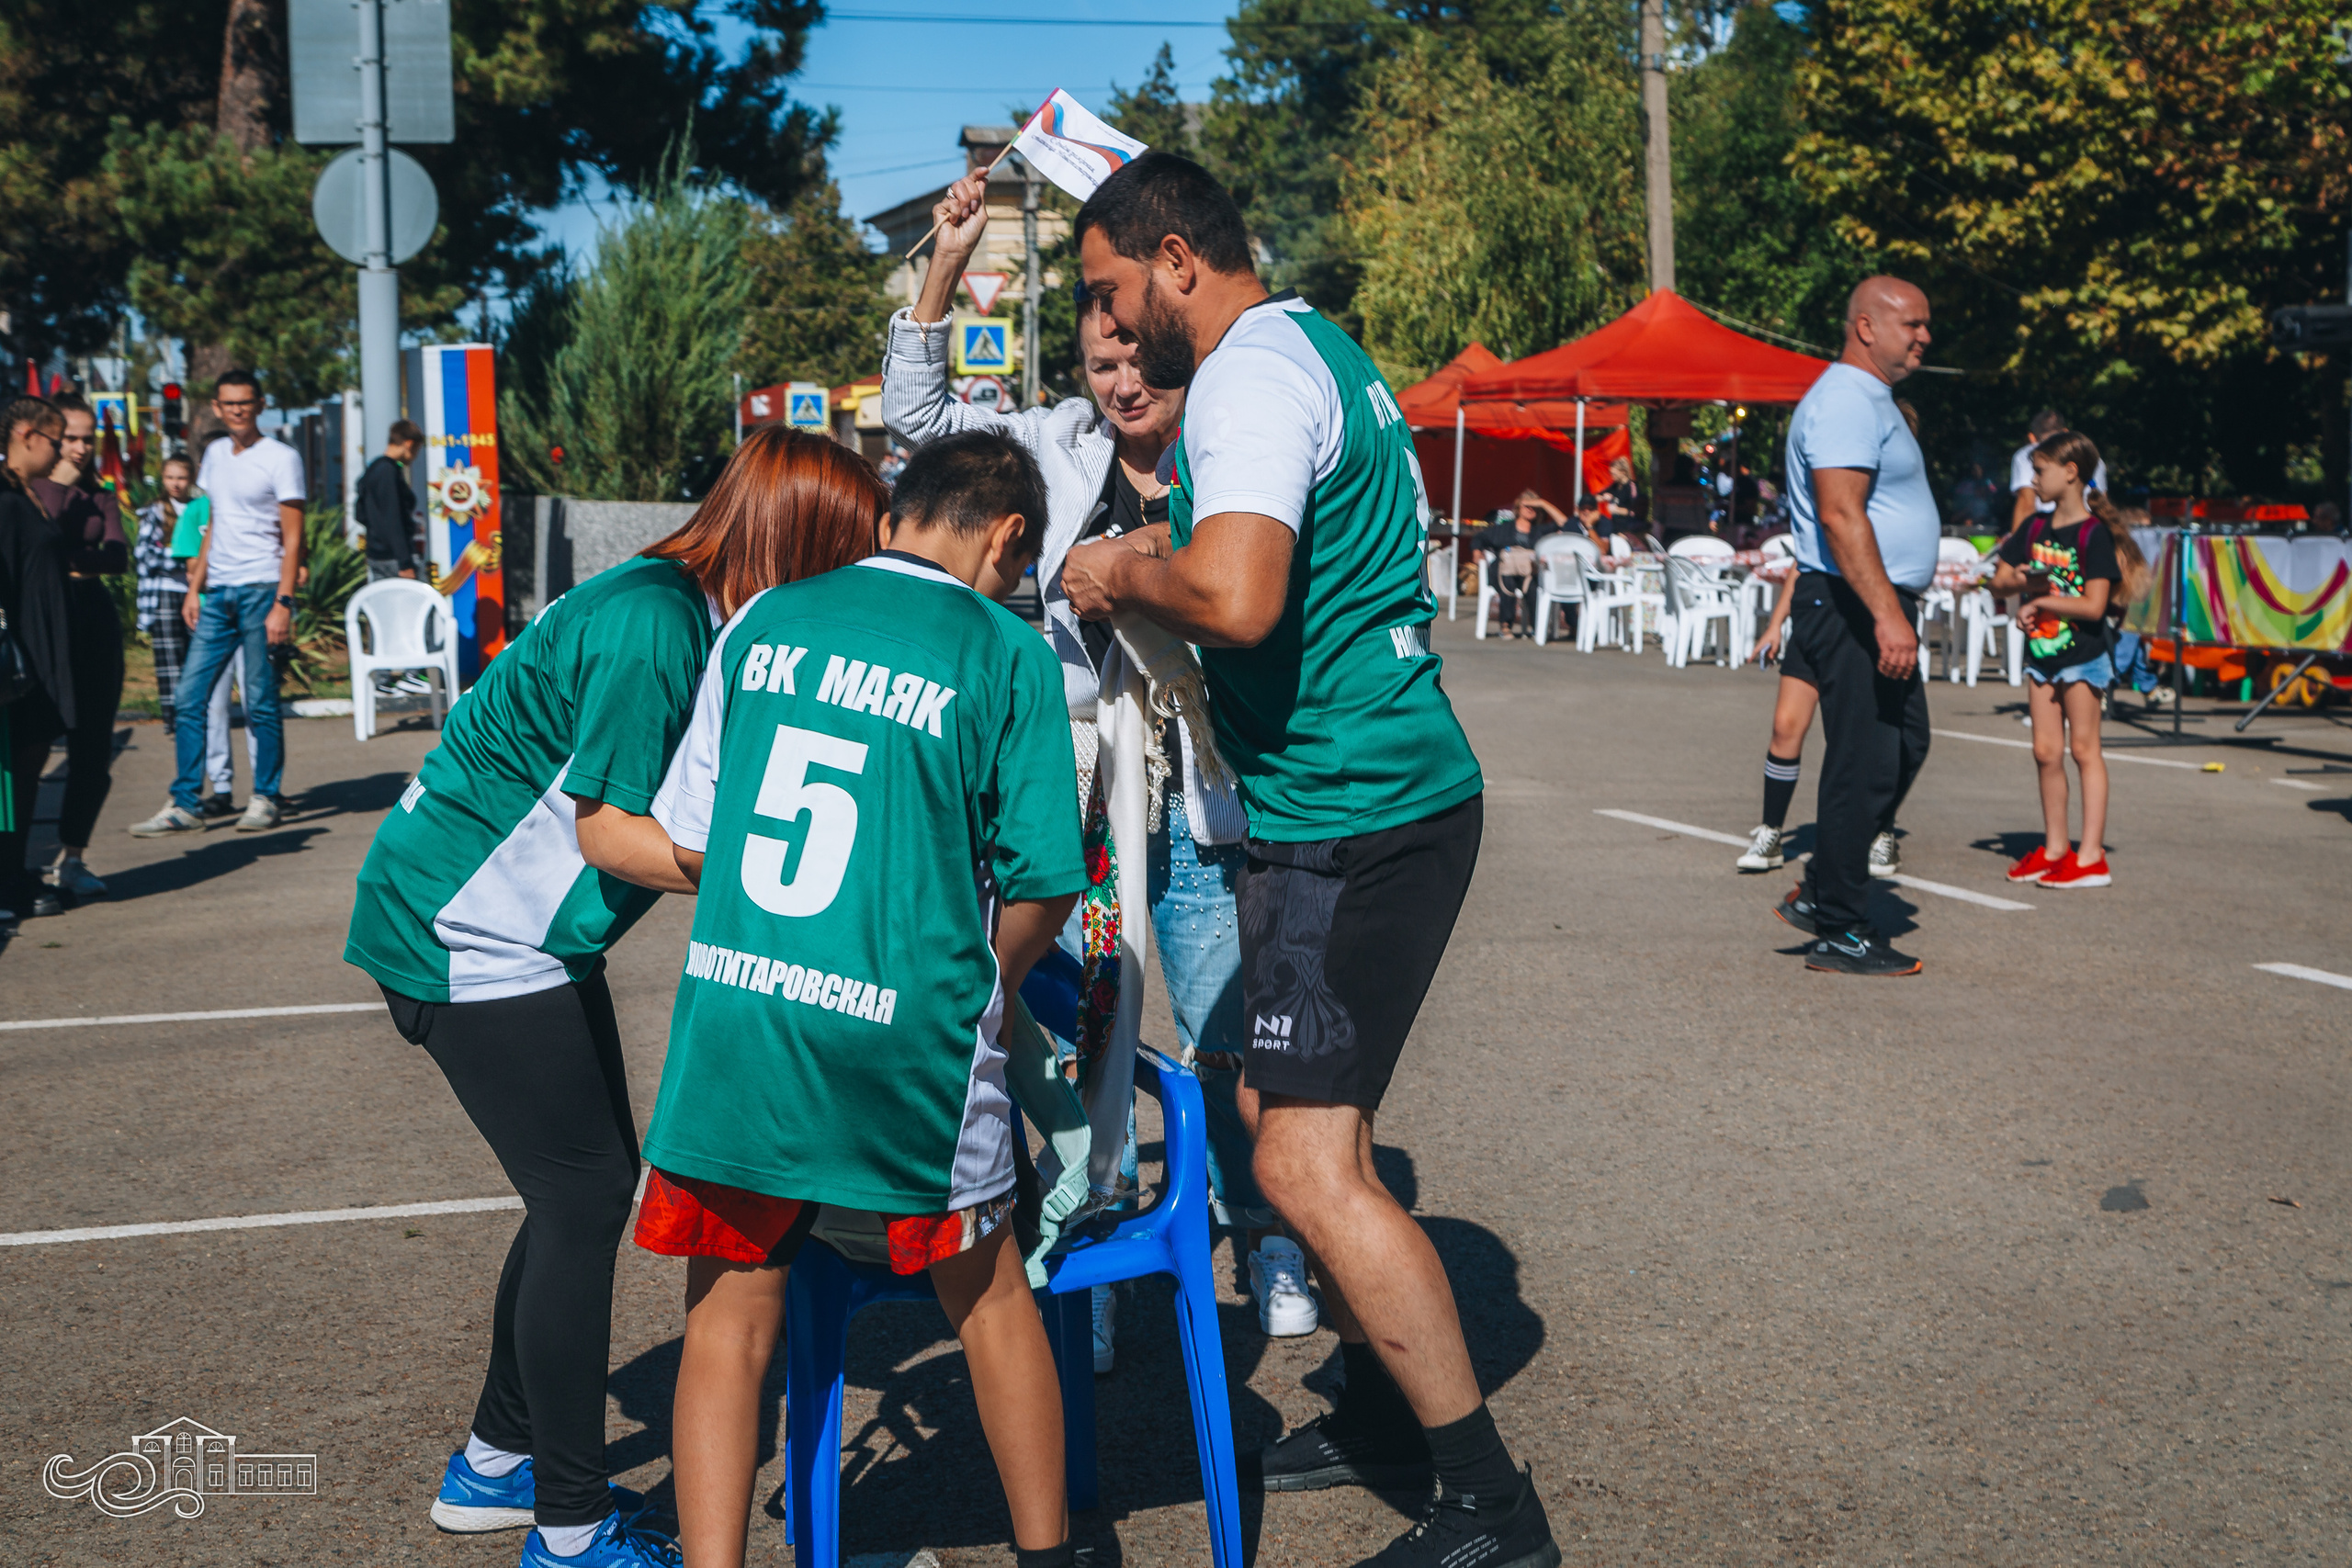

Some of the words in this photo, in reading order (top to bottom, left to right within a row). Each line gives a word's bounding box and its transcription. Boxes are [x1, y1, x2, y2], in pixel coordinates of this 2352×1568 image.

[425, 433, 496, 448] 941-1945
[741, 643, 809, 696] ВК
[815, 654, 958, 739] МАЯК
[740, 723, 870, 918] 5
[684, 940, 898, 1026] НОВОТИТАРОВСКАЯ
[1251, 1038, 1291, 1052] SPORT
